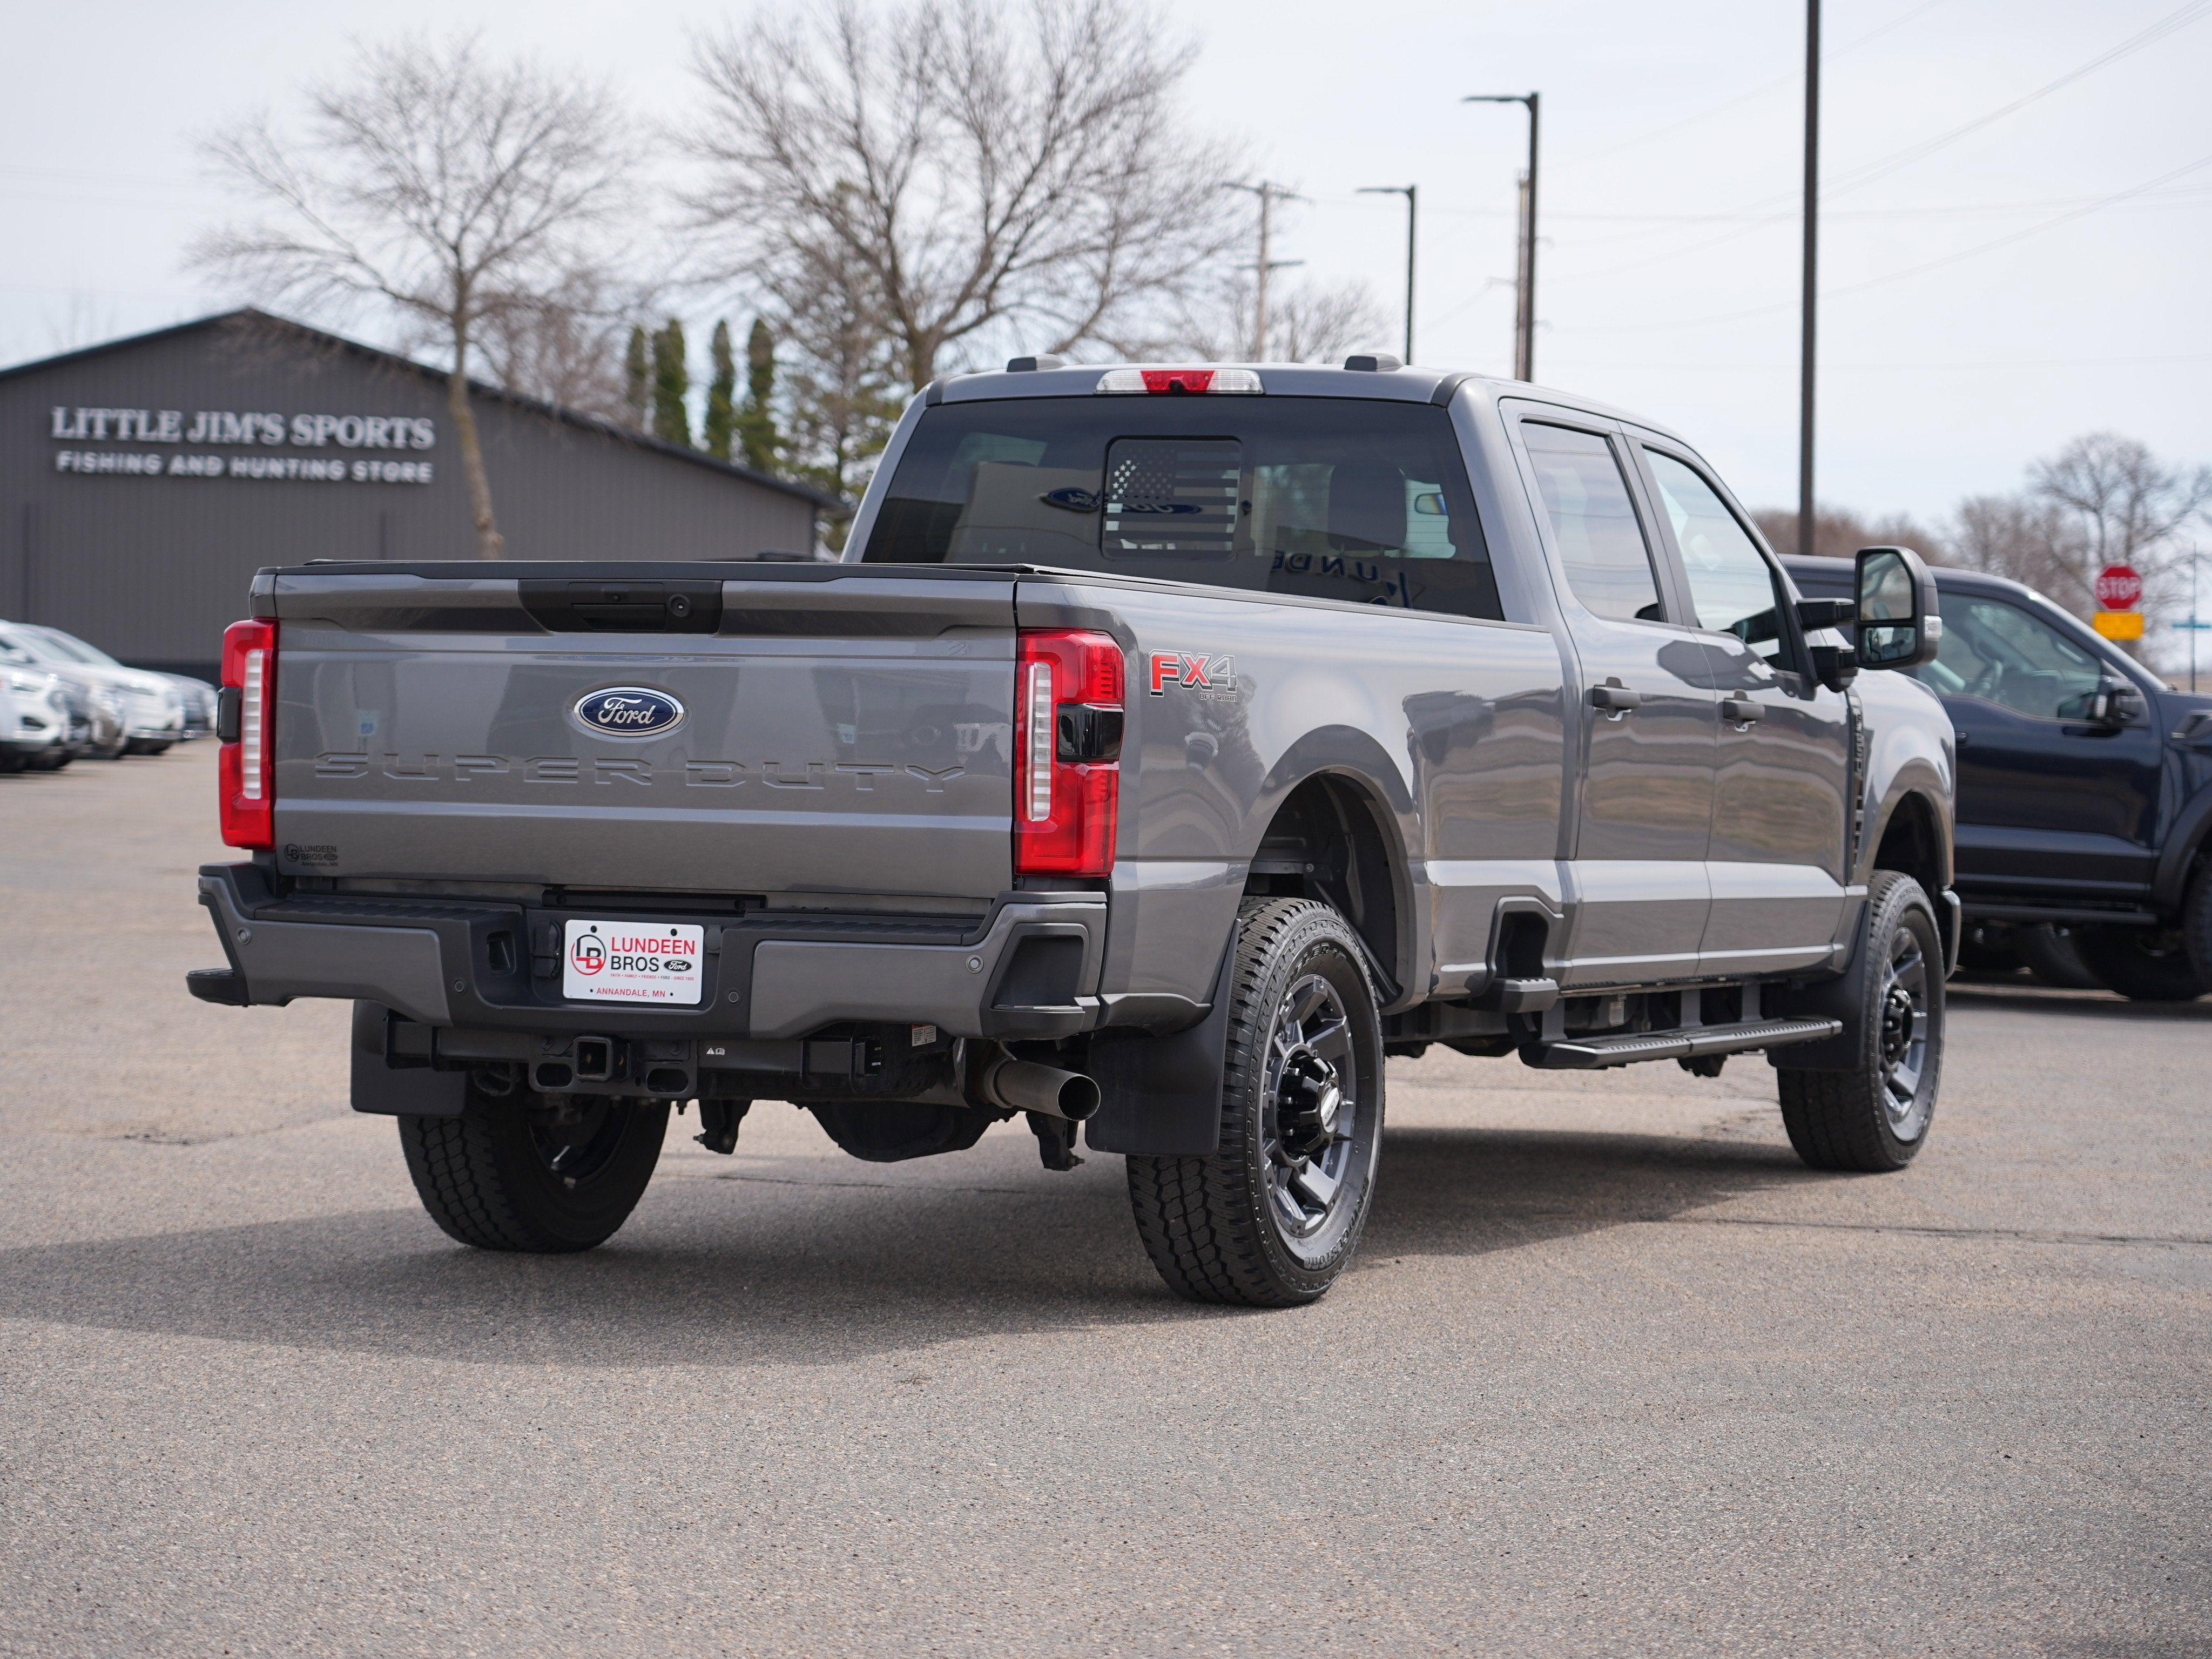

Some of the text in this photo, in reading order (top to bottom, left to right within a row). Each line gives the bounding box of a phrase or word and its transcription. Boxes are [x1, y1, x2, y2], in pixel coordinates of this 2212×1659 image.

[52, 406, 436, 450] LITTLE JIM'S SPORTS
[56, 450, 433, 484] FISHING AND HUNTING STORE
[2099, 576, 2141, 601] STOP
[1149, 649, 1238, 698] FX4
[598, 697, 656, 724] Ford
[1199, 693, 1237, 703] OFF ROAD
[315, 752, 965, 793] SUPER DUTY
[611, 937, 696, 955] LUNDEEN
[611, 955, 687, 972] BROS Ford
[596, 987, 650, 998] ANNANDALE,
